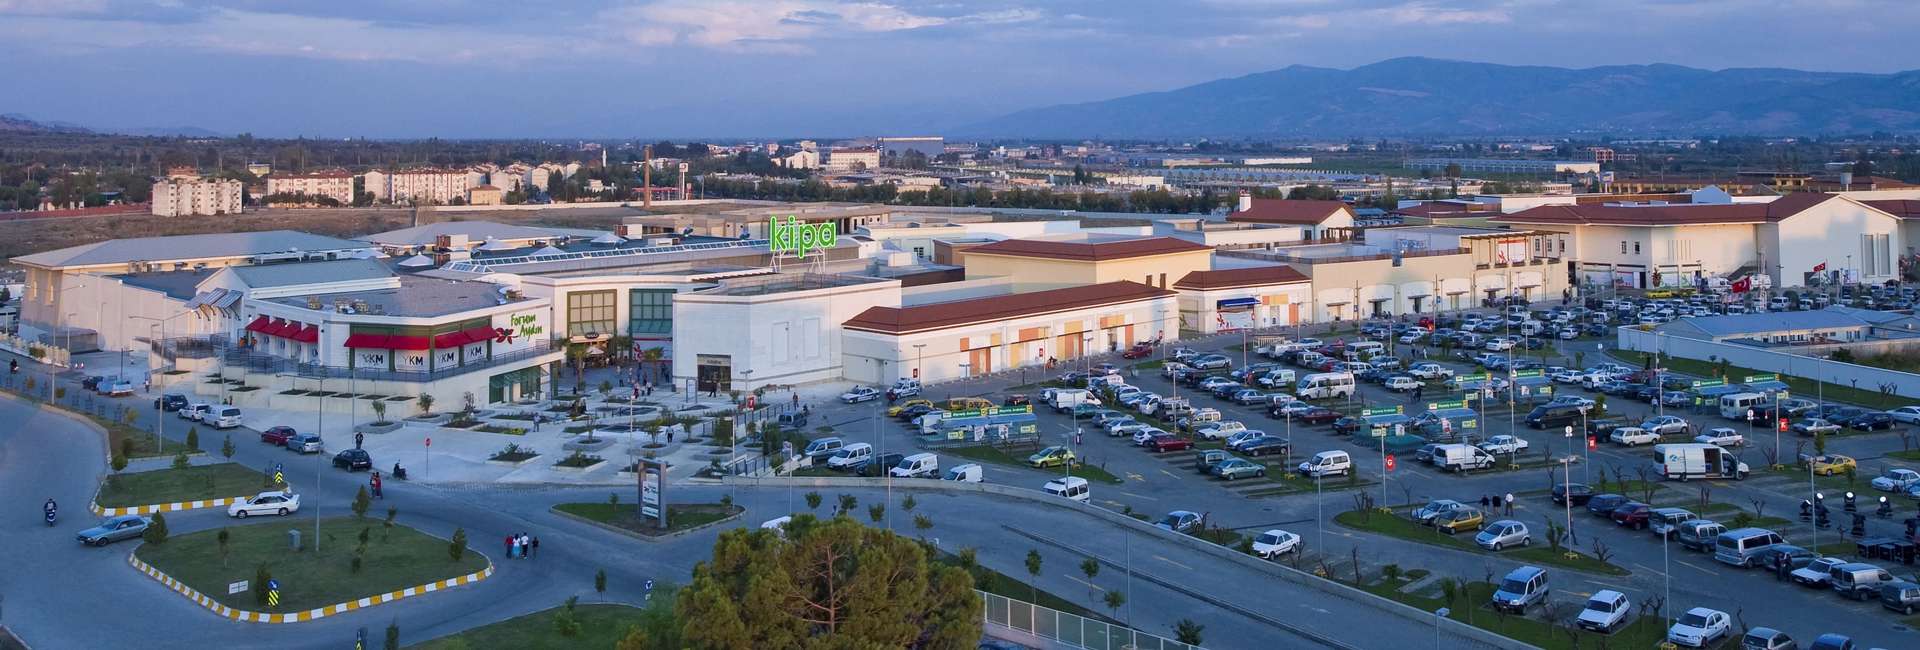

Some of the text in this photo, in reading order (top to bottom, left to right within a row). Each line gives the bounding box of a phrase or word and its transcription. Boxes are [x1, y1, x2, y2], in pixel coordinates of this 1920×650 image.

[770, 215, 836, 259] kipa
[511, 313, 536, 326] Forum
[362, 354, 384, 364] YKM
[404, 355, 424, 366] YKM
[438, 352, 455, 362] YKM
